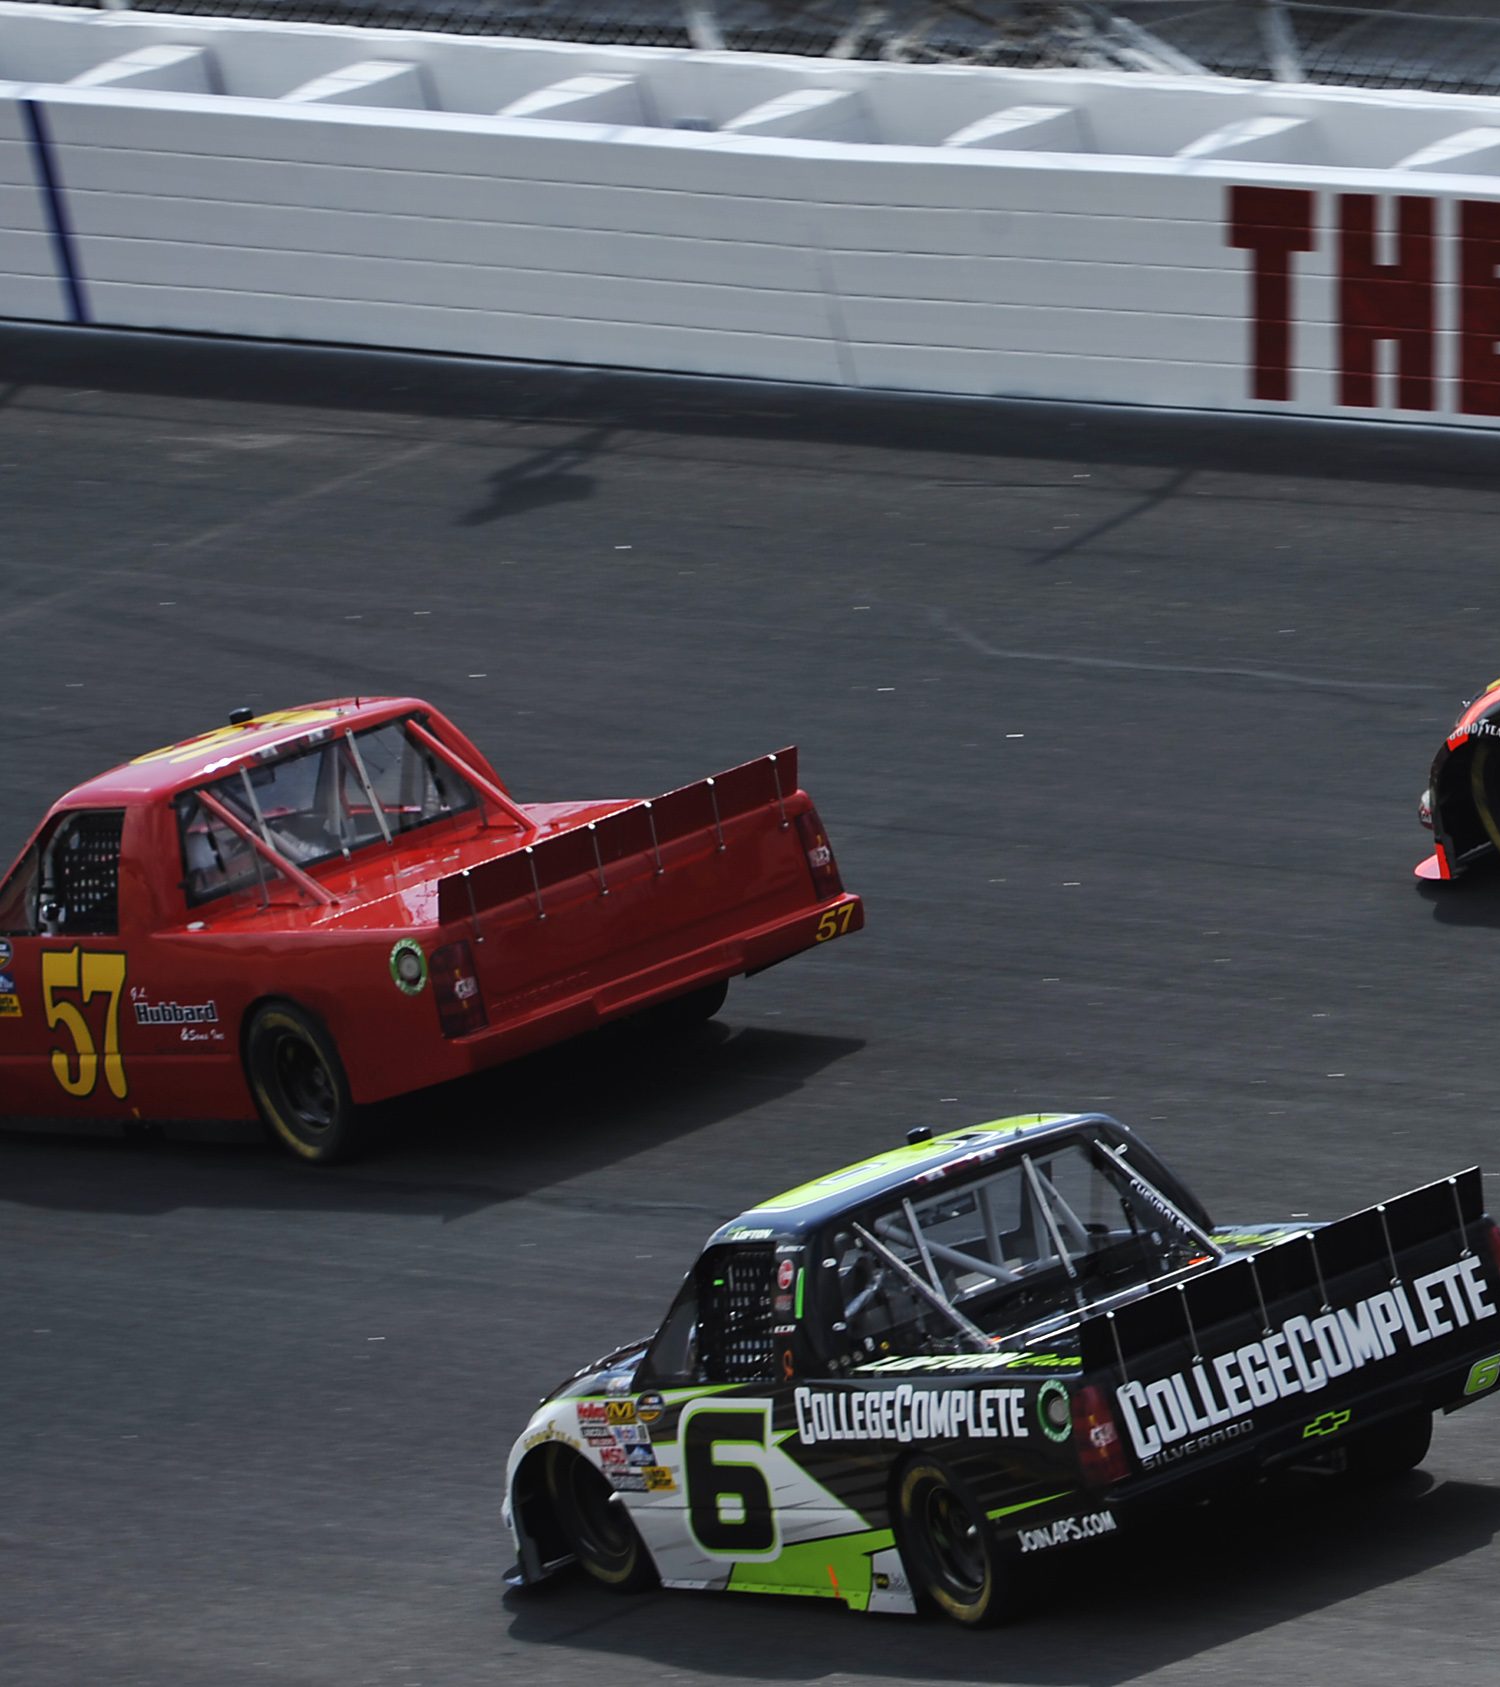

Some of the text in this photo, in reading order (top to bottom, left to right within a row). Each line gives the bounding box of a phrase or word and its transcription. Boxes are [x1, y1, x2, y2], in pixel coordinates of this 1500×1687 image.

[815, 902, 856, 942] 57
[41, 945, 128, 1100] 57
[134, 1000, 219, 1024] Hubbard
[1142, 1419, 1254, 1471] SILVERADO
[677, 1398, 782, 1563] 6
